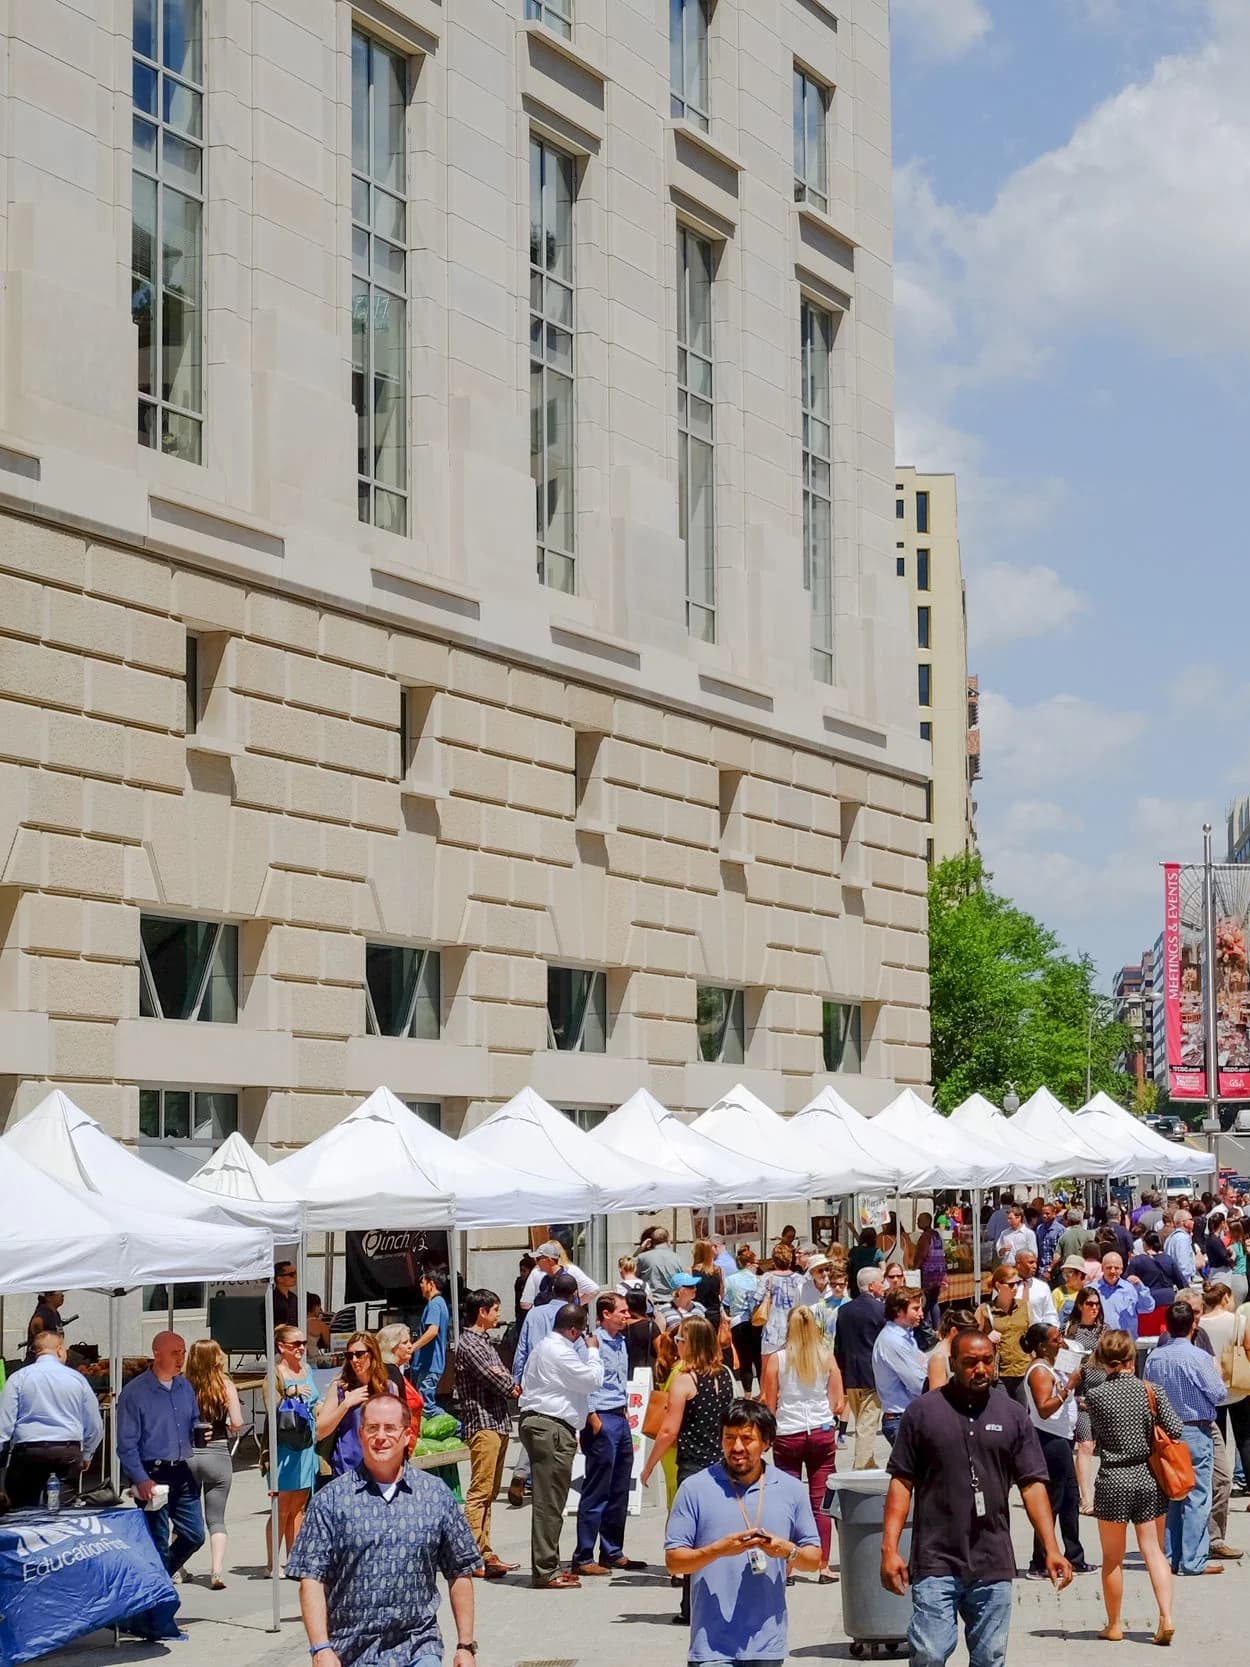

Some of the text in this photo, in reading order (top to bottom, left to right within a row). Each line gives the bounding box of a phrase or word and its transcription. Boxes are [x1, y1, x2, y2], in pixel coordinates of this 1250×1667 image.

[1167, 873, 1179, 1000] MEETINGS & EVENTS
[1229, 1079, 1245, 1088] GSA
